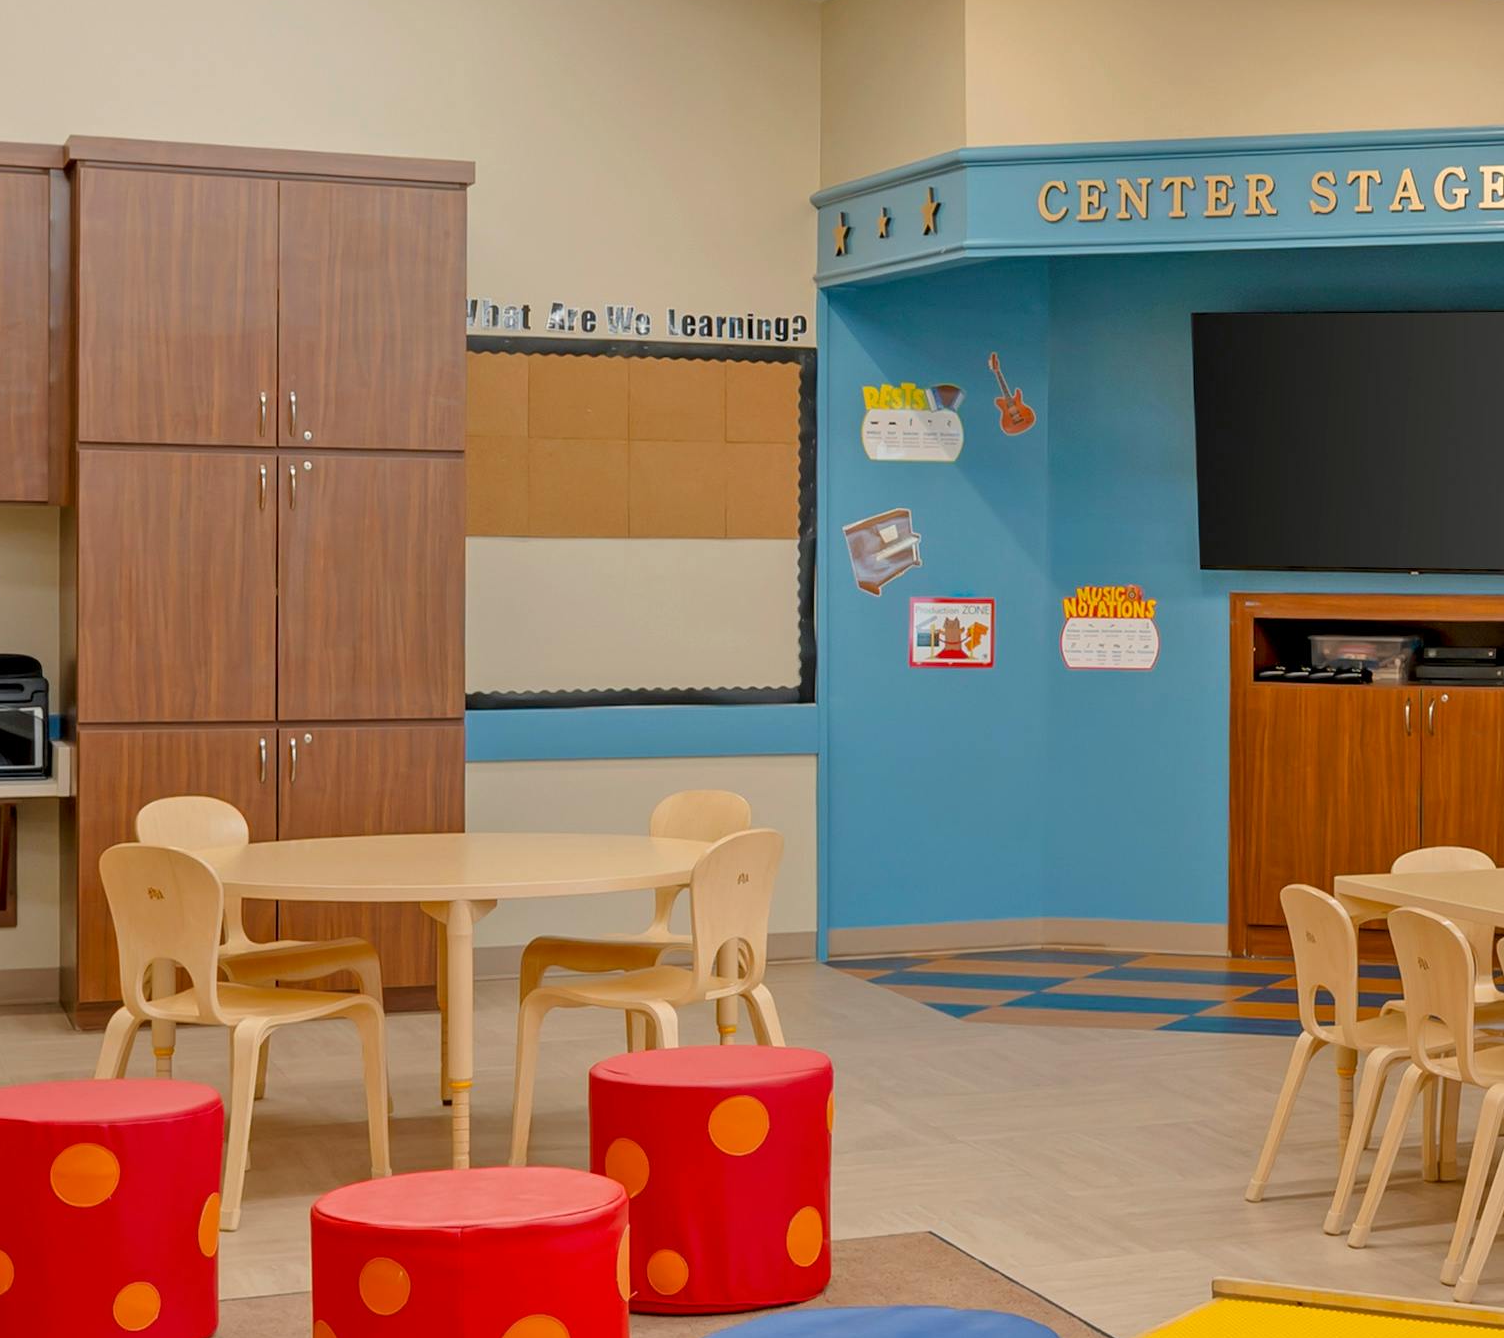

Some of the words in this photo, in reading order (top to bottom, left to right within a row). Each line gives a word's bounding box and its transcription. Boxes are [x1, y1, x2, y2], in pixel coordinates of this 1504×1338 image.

[1037, 173, 1279, 223] CENTER
[548, 303, 596, 332] Are
[607, 306, 650, 336] We
[668, 309, 808, 342] Learning?
[862, 382, 926, 410] RESTS
[1076, 586, 1125, 602] MUSIC
[962, 605, 990, 614] ZONE
[1063, 598, 1157, 618] NOTATIONS
